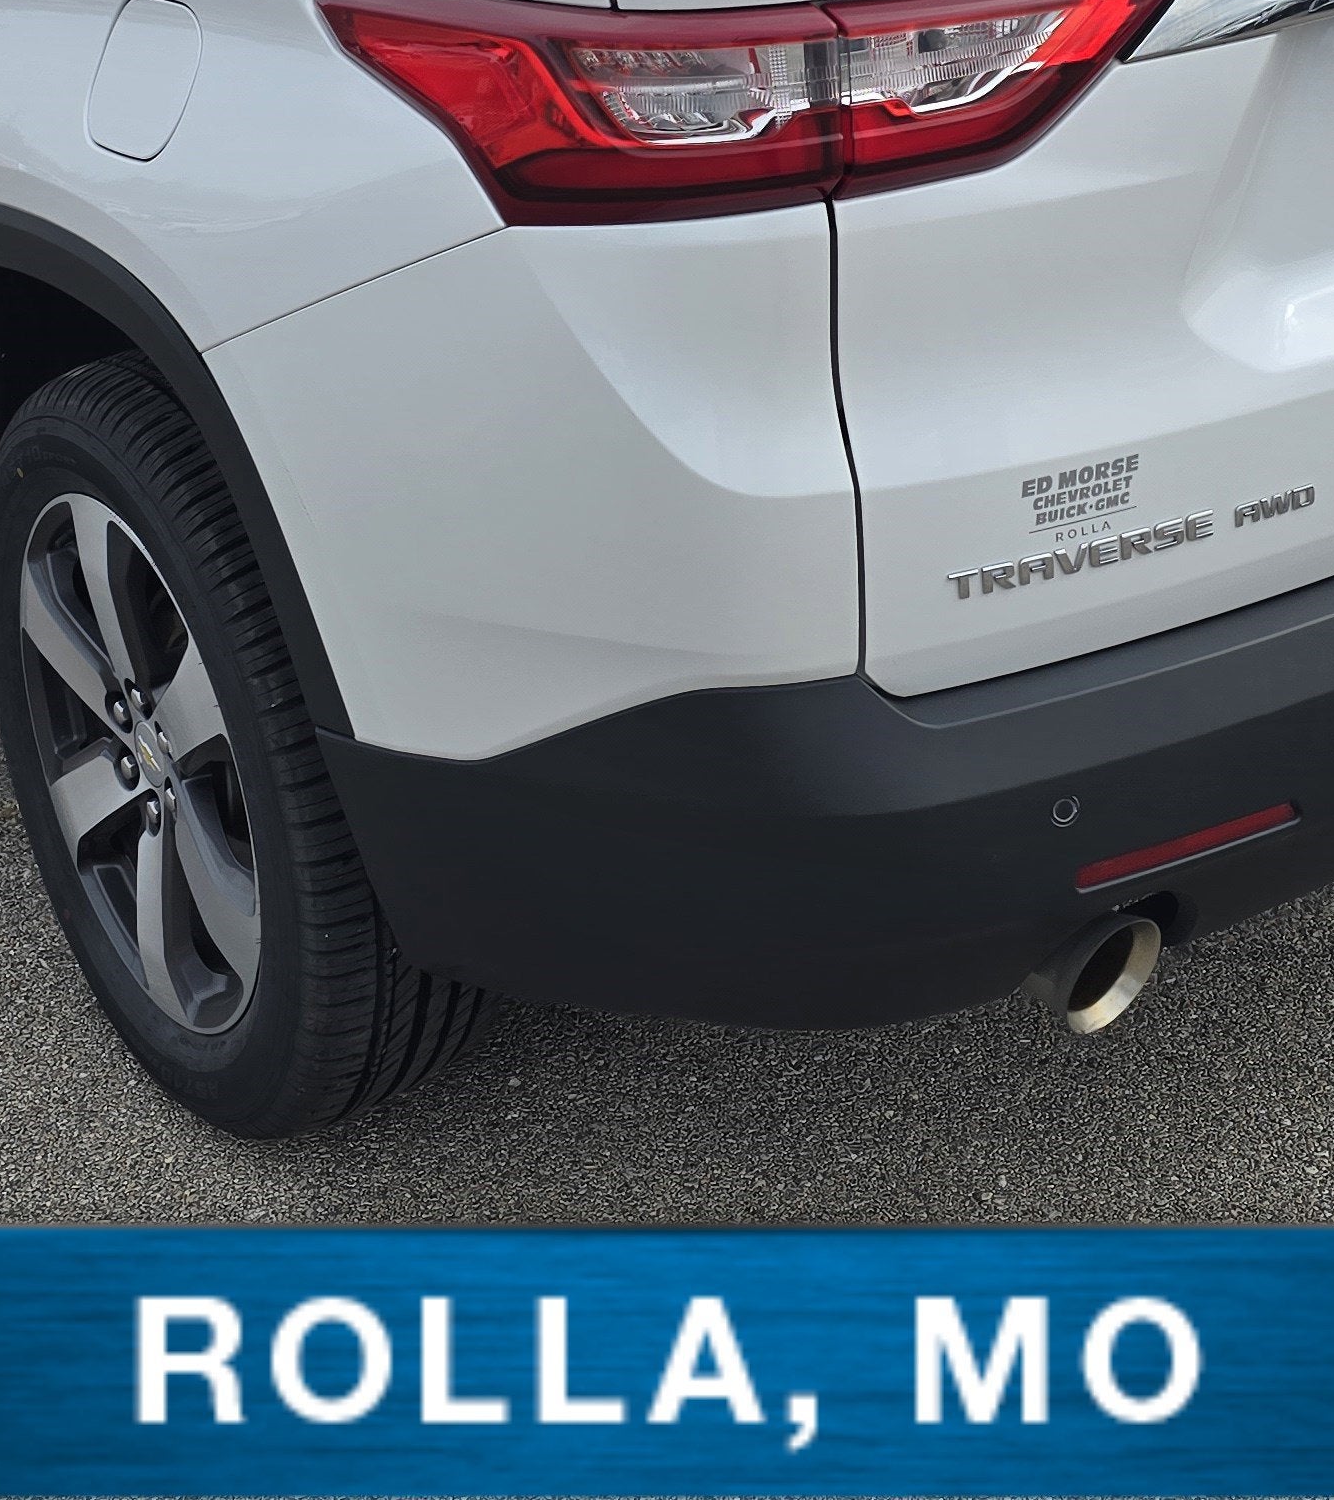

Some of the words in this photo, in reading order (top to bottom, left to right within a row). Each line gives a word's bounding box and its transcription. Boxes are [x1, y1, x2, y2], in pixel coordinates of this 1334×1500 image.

[1021, 475, 1053, 499] ED
[1057, 453, 1140, 491] MORSE
[1032, 475, 1133, 512] CHEVROLET
[946, 508, 1215, 601] TRAVERSE
[1234, 483, 1316, 528] AWD
[1055, 520, 1112, 543] ROLLA
